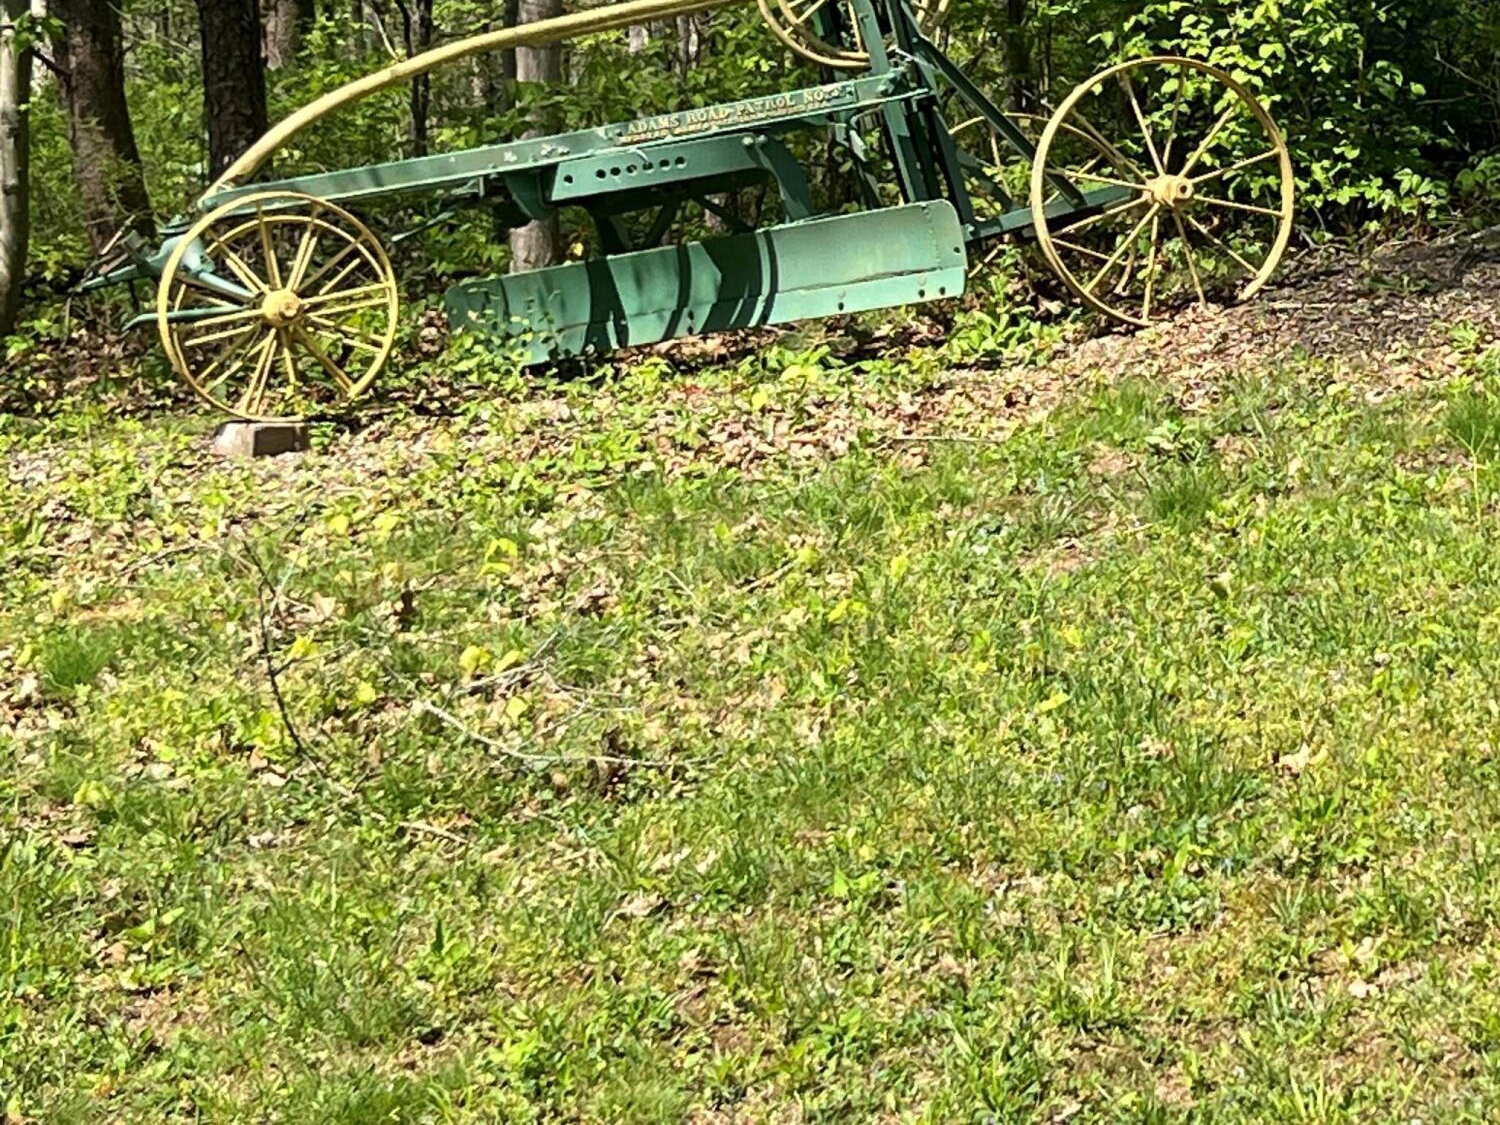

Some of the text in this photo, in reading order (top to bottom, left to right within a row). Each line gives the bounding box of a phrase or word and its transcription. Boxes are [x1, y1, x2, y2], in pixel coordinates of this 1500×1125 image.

[627, 115, 681, 134] ADAMS
[687, 107, 730, 125] ROAD
[736, 93, 796, 116] PATROL
